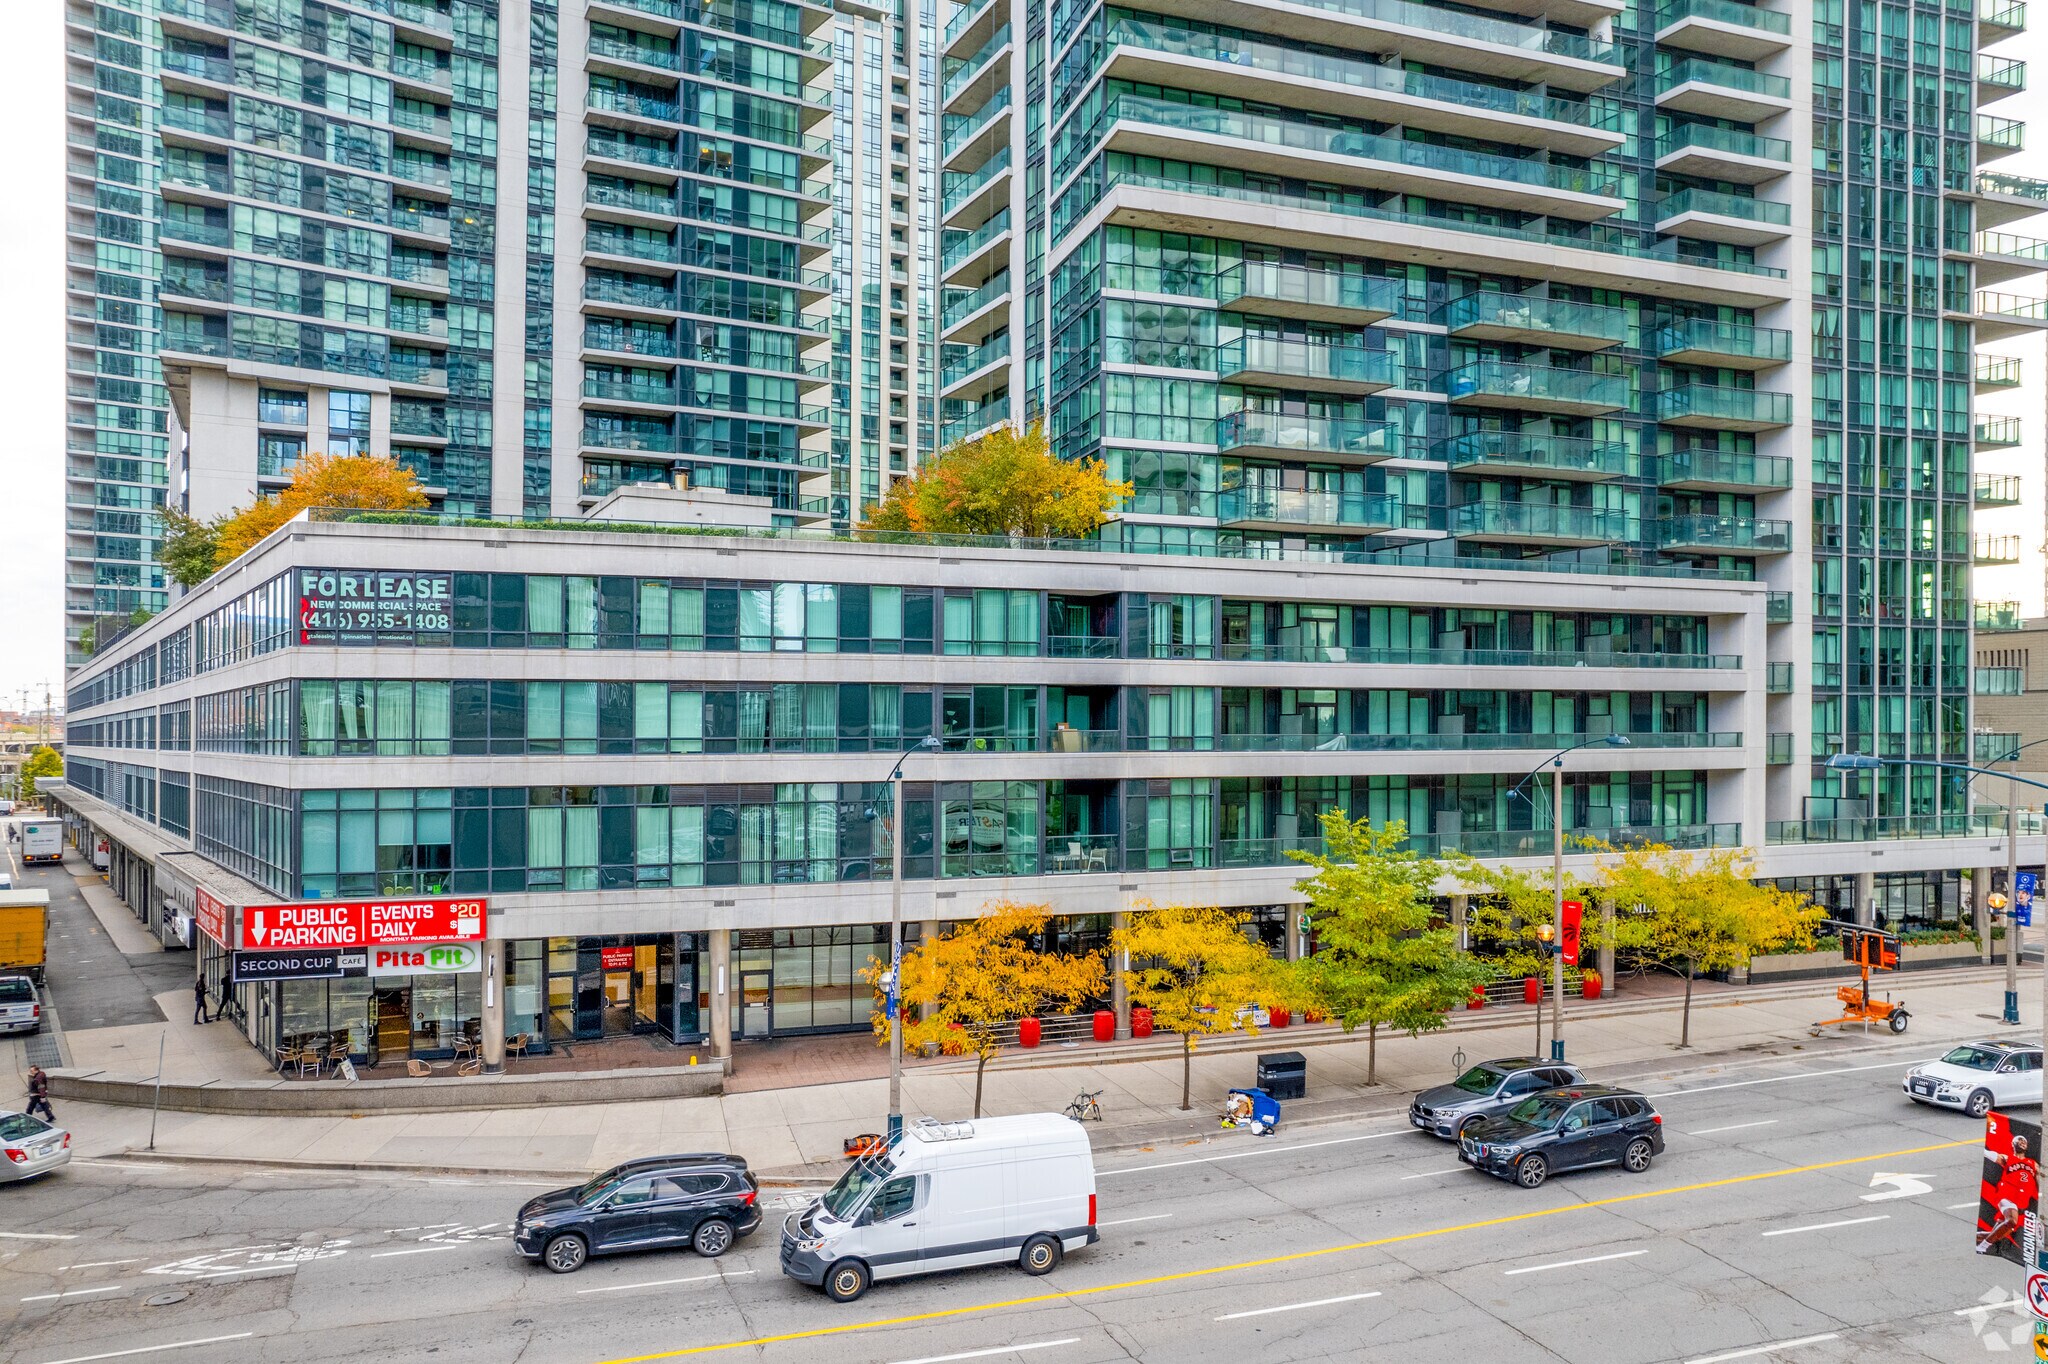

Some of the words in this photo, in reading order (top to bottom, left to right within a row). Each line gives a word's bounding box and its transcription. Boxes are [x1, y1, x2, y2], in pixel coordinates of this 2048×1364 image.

[303, 576, 358, 597] FOR
[364, 577, 448, 599] LEASE
[310, 600, 335, 609] NEW
[279, 907, 348, 927] PUBLIC
[371, 904, 434, 920] EVENTS
[450, 903, 480, 918] $20
[270, 925, 357, 946] PARKING
[371, 921, 417, 938] DAILY
[240, 959, 301, 971] SECOND
[303, 957, 333, 969] CUP
[341, 957, 362, 965] CAFÉ
[376, 951, 425, 968] Pita
[430, 948, 463, 966] Pit
[1990, 1121, 1997, 1135] 2
[2020, 1171, 2029, 1183] 2
[2022, 1210, 2037, 1265] MCDANIELS
